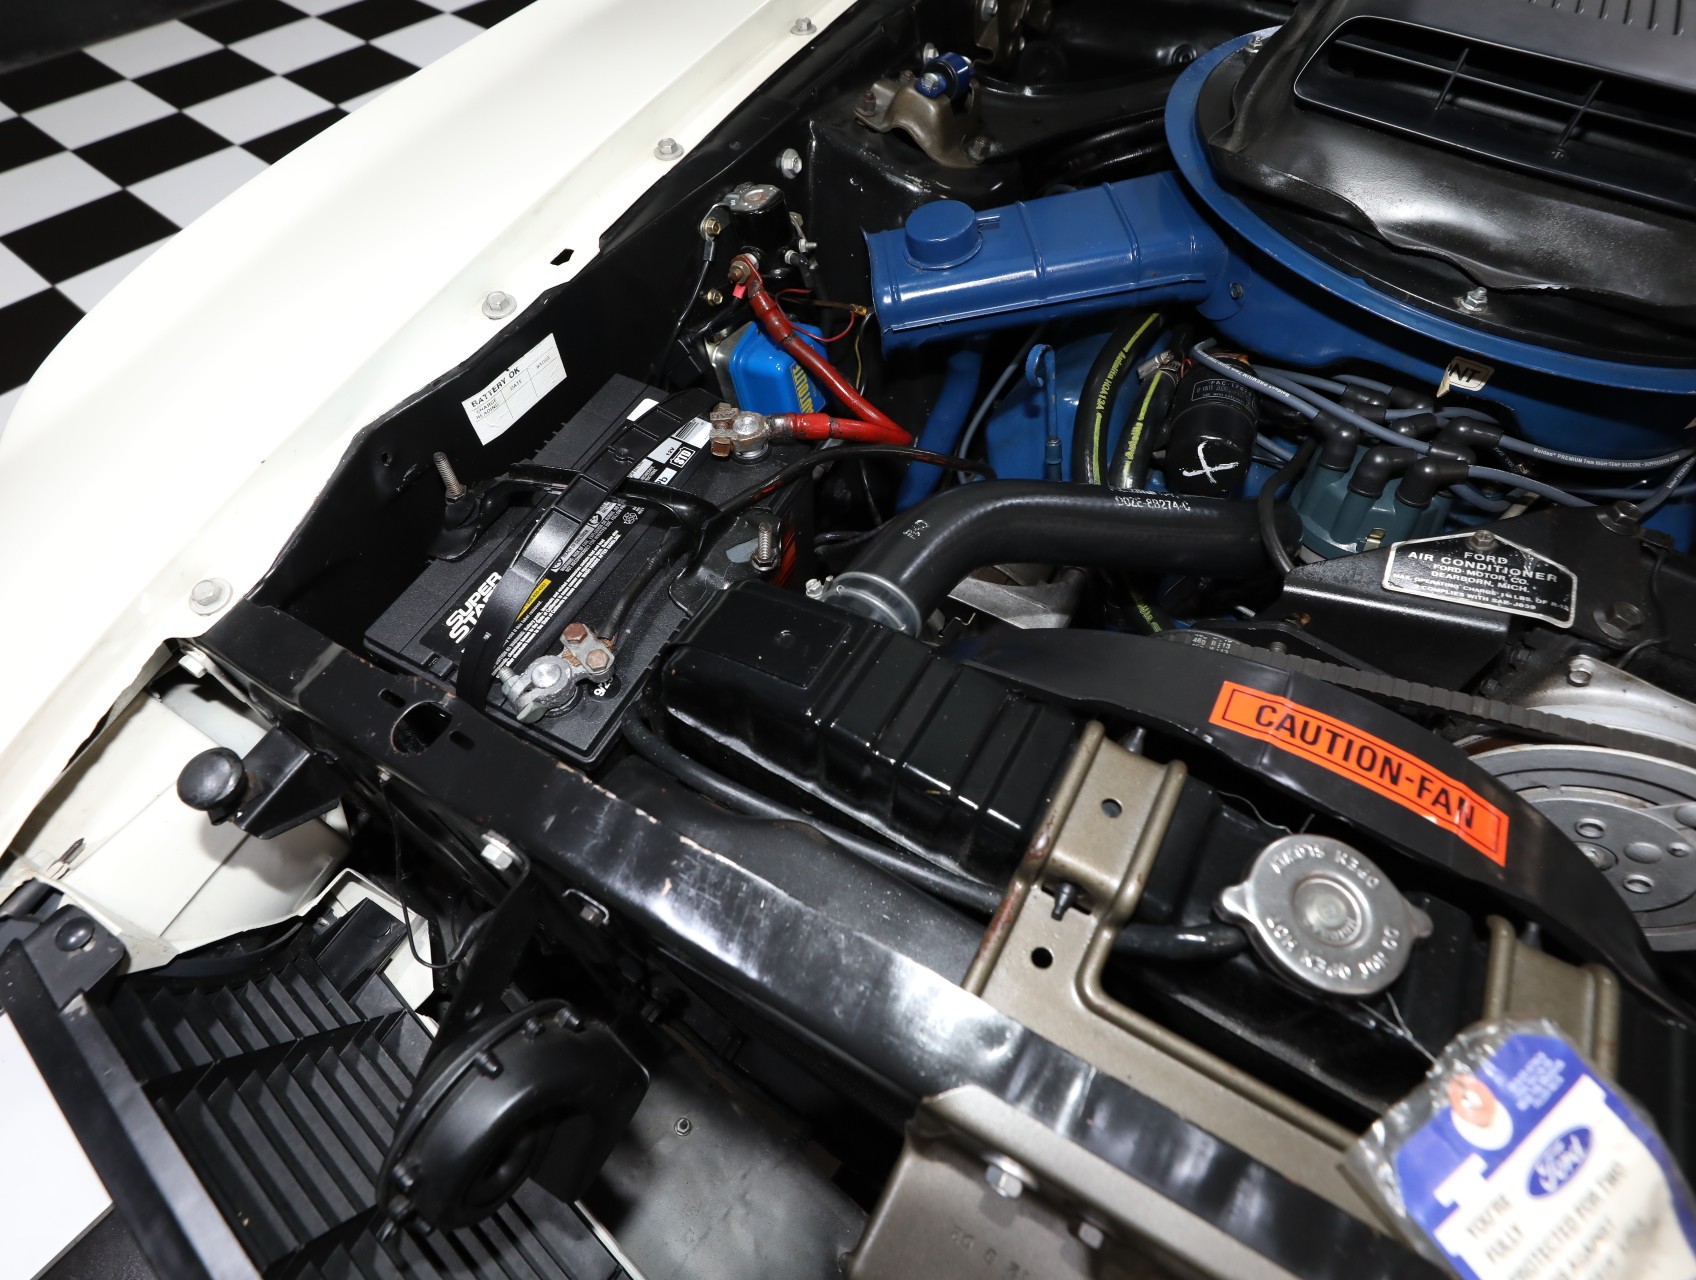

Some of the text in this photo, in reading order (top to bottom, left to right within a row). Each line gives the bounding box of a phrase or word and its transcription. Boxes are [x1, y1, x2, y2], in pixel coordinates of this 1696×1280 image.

[1106, 351, 1125, 379] Autolite
[470, 366, 520, 407] BATTERY OK
[509, 379, 521, 391] DATE
[1241, 372, 1267, 386] PREMIUM
[664, 446, 675, 456] 12V
[672, 447, 692, 466] STD
[1557, 453, 1581, 463] PREMIUM
[1407, 550, 1557, 582] AIR CONDITIONER
[1463, 550, 1508, 565] FORD
[1430, 569, 1530, 593] DEARBORN, MICH.
[1433, 563, 1529, 585] FORD MOTOR CO.
[444, 570, 502, 630] SUPER
[1413, 576, 1459, 589] OPERATING
[1462, 585, 1496, 596] CHARGE
[1513, 594, 1533, 603] LBS.
[1534, 597, 1548, 605] OF
[1470, 593, 1490, 601] WITH
[447, 584, 497, 643] STA
[1253, 702, 1478, 830] CAUTION-FAN
[1534, 1133, 1586, 1194] Ford
